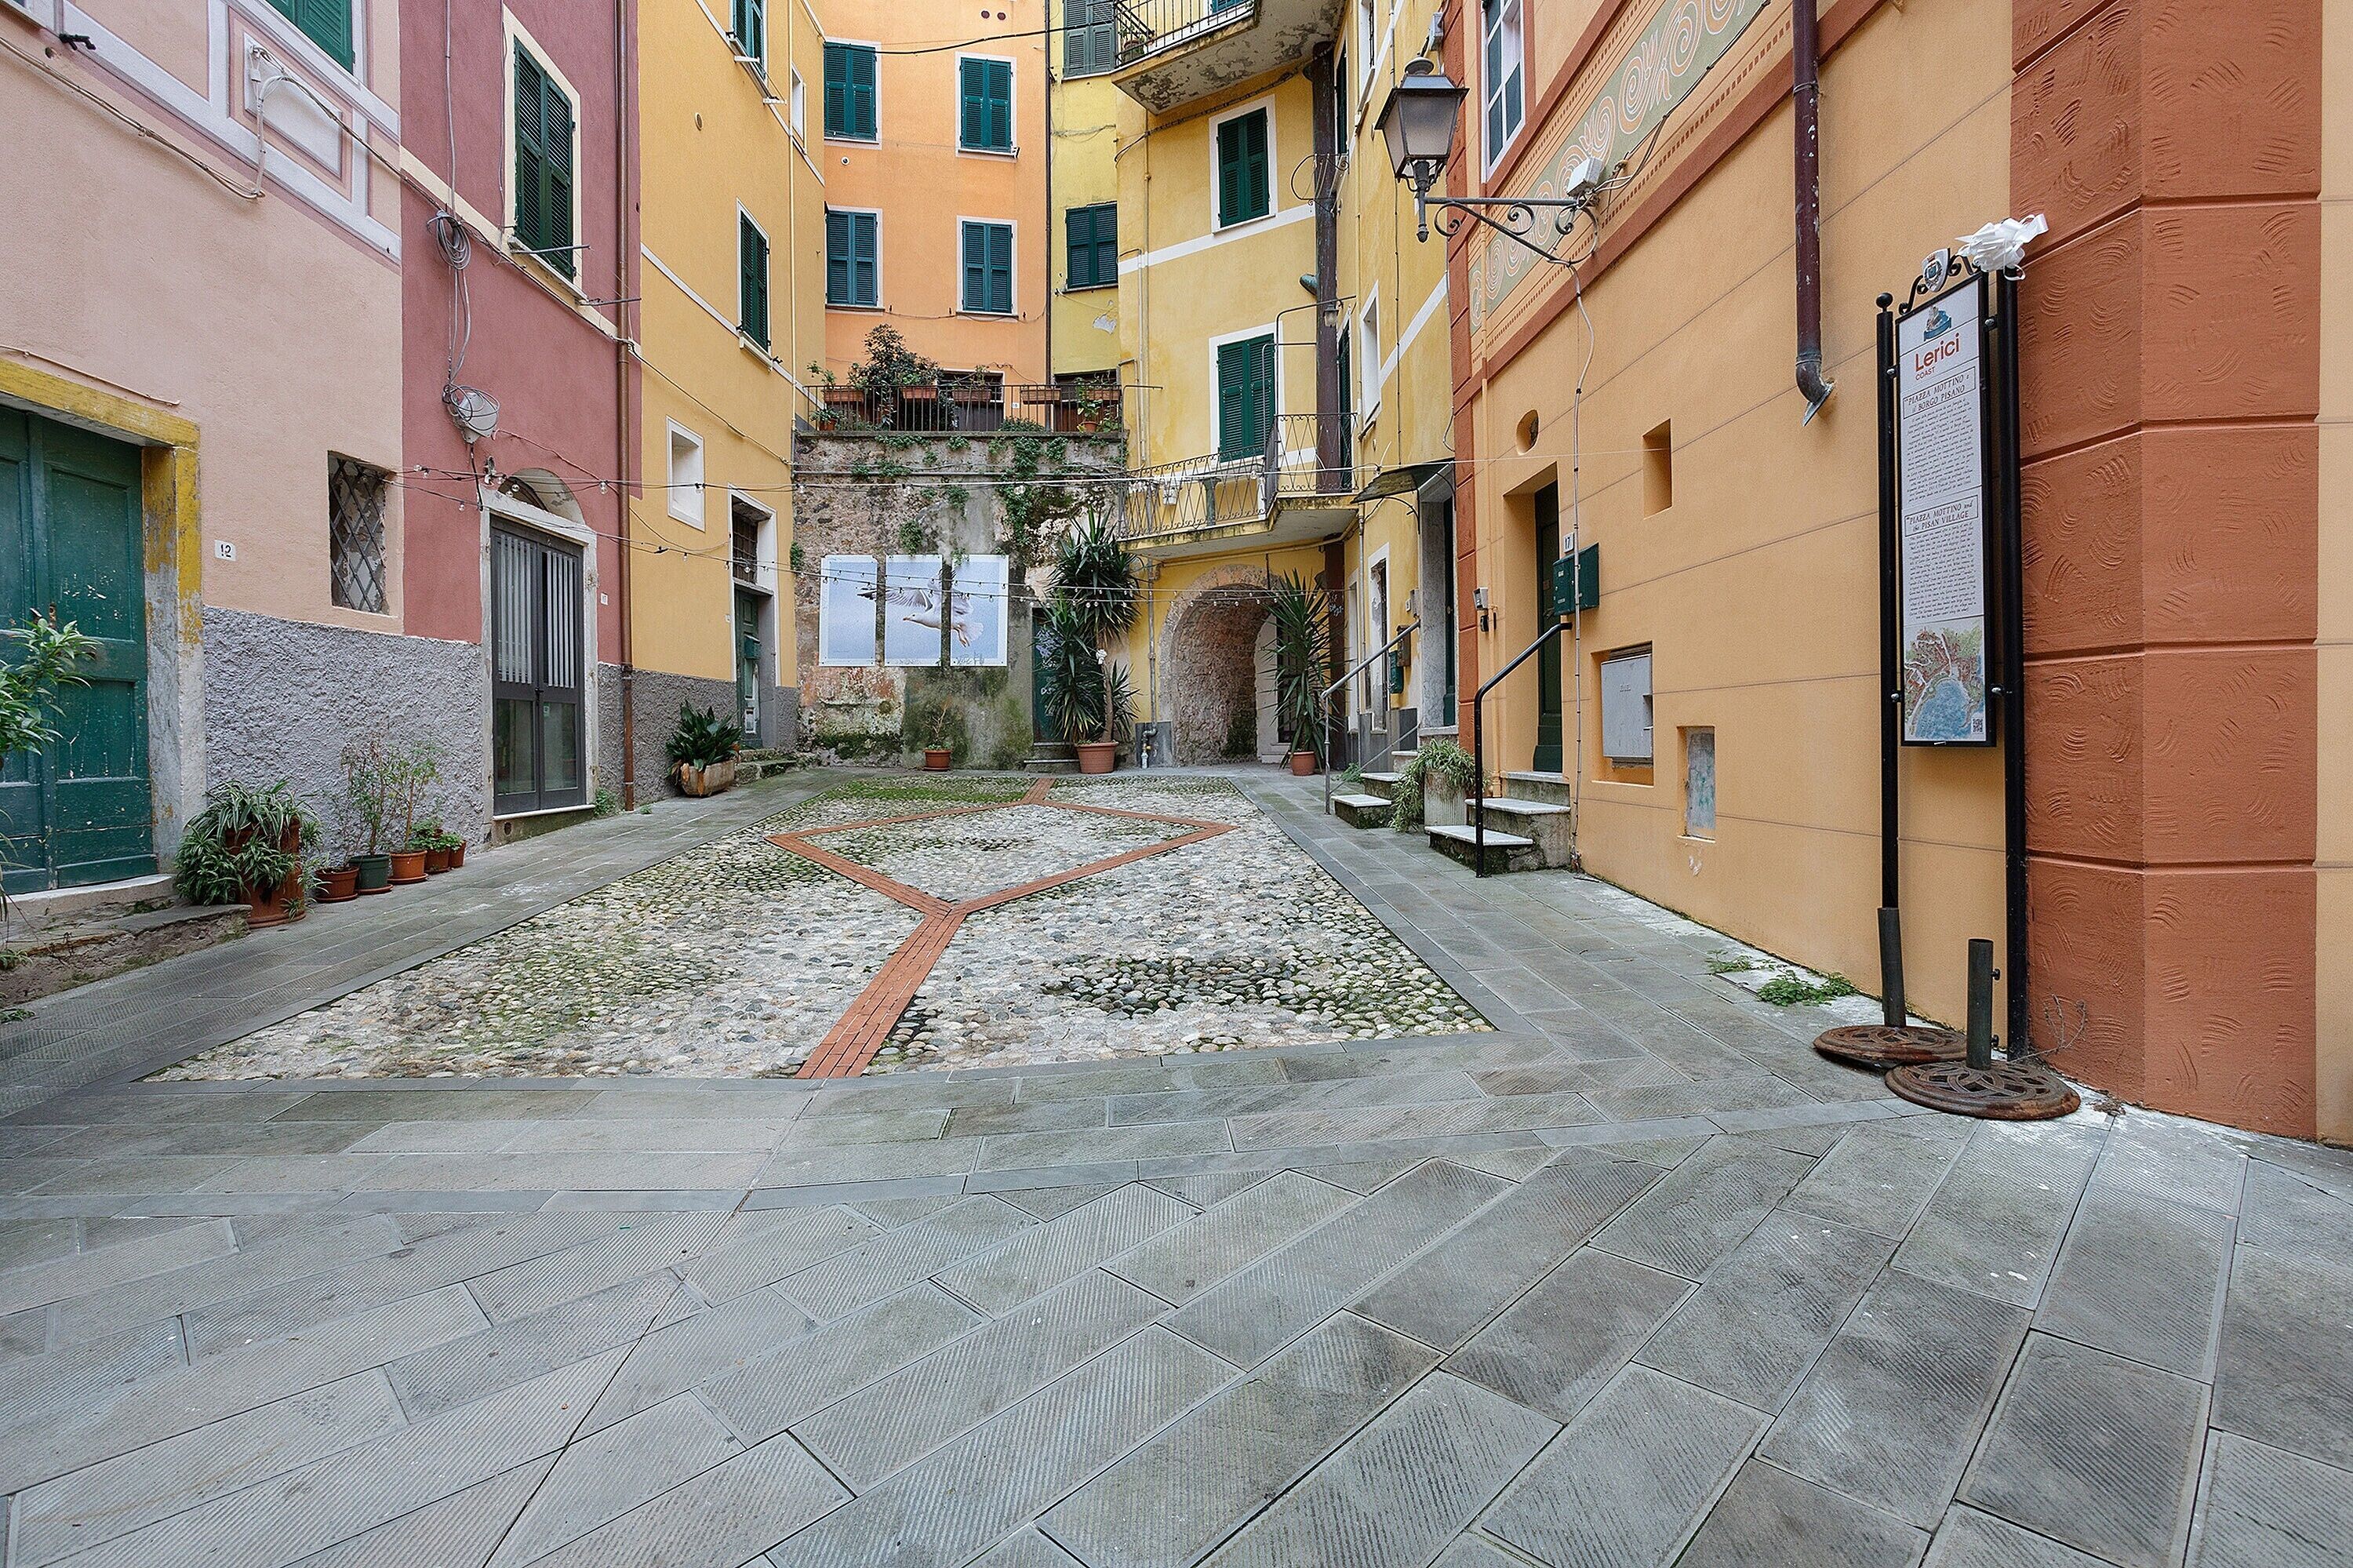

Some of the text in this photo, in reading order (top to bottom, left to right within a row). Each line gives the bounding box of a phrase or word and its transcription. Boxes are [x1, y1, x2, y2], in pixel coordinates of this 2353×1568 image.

[1915, 333, 1960, 372] Lerici
[1915, 366, 1936, 380] COAST
[1933, 374, 1964, 395] MOTTINO
[1918, 396, 1939, 411] BORGO
[1940, 384, 1965, 402] PISANO
[1933, 503, 1962, 518] MOTTINO
[1922, 518, 1939, 530] PISAN
[1941, 511, 1969, 523] VILLAGE
[220, 544, 231, 558] 12
[1565, 537, 1571, 550] 17
